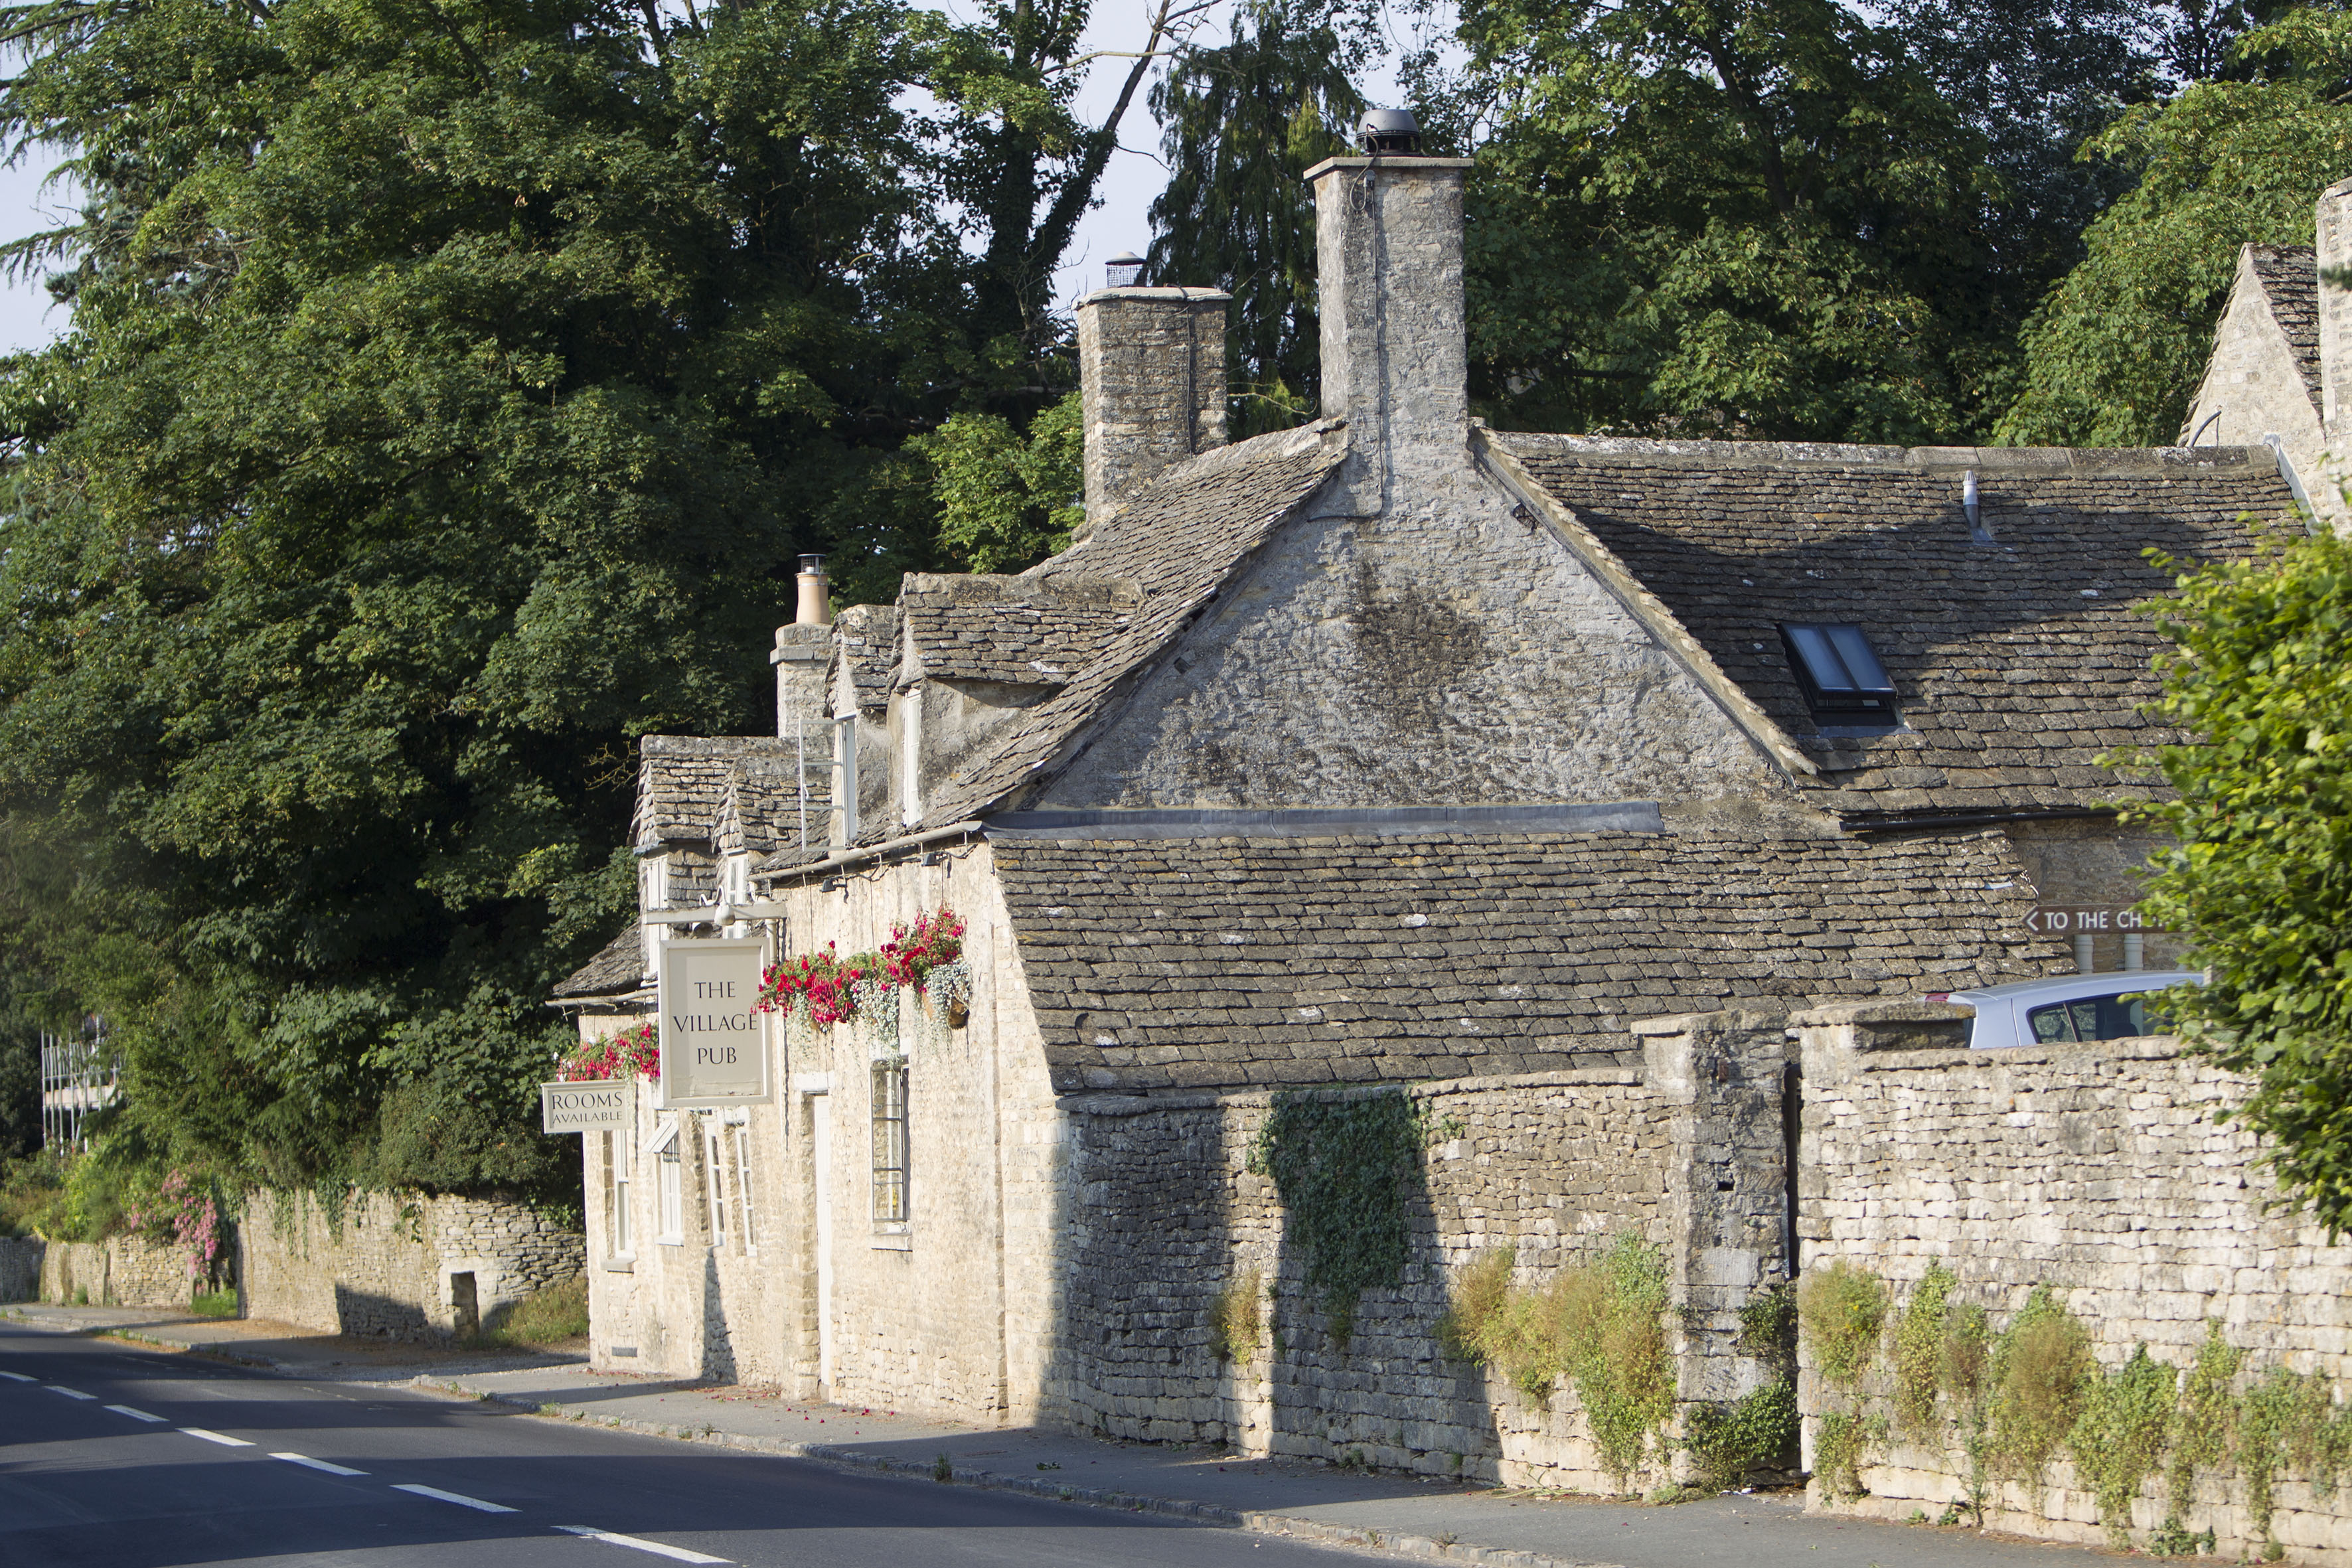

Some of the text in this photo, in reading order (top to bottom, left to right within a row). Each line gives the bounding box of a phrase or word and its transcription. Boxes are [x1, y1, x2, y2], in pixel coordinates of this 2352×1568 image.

[2045, 911, 2069, 929] TO
[2077, 911, 2108, 929] THE
[694, 981, 736, 998] THE
[673, 1013, 757, 1033] VILLAGE
[697, 1046, 737, 1065] PUB
[552, 1091, 623, 1109] ROOMS
[552, 1111, 622, 1124] AVAILABLE
